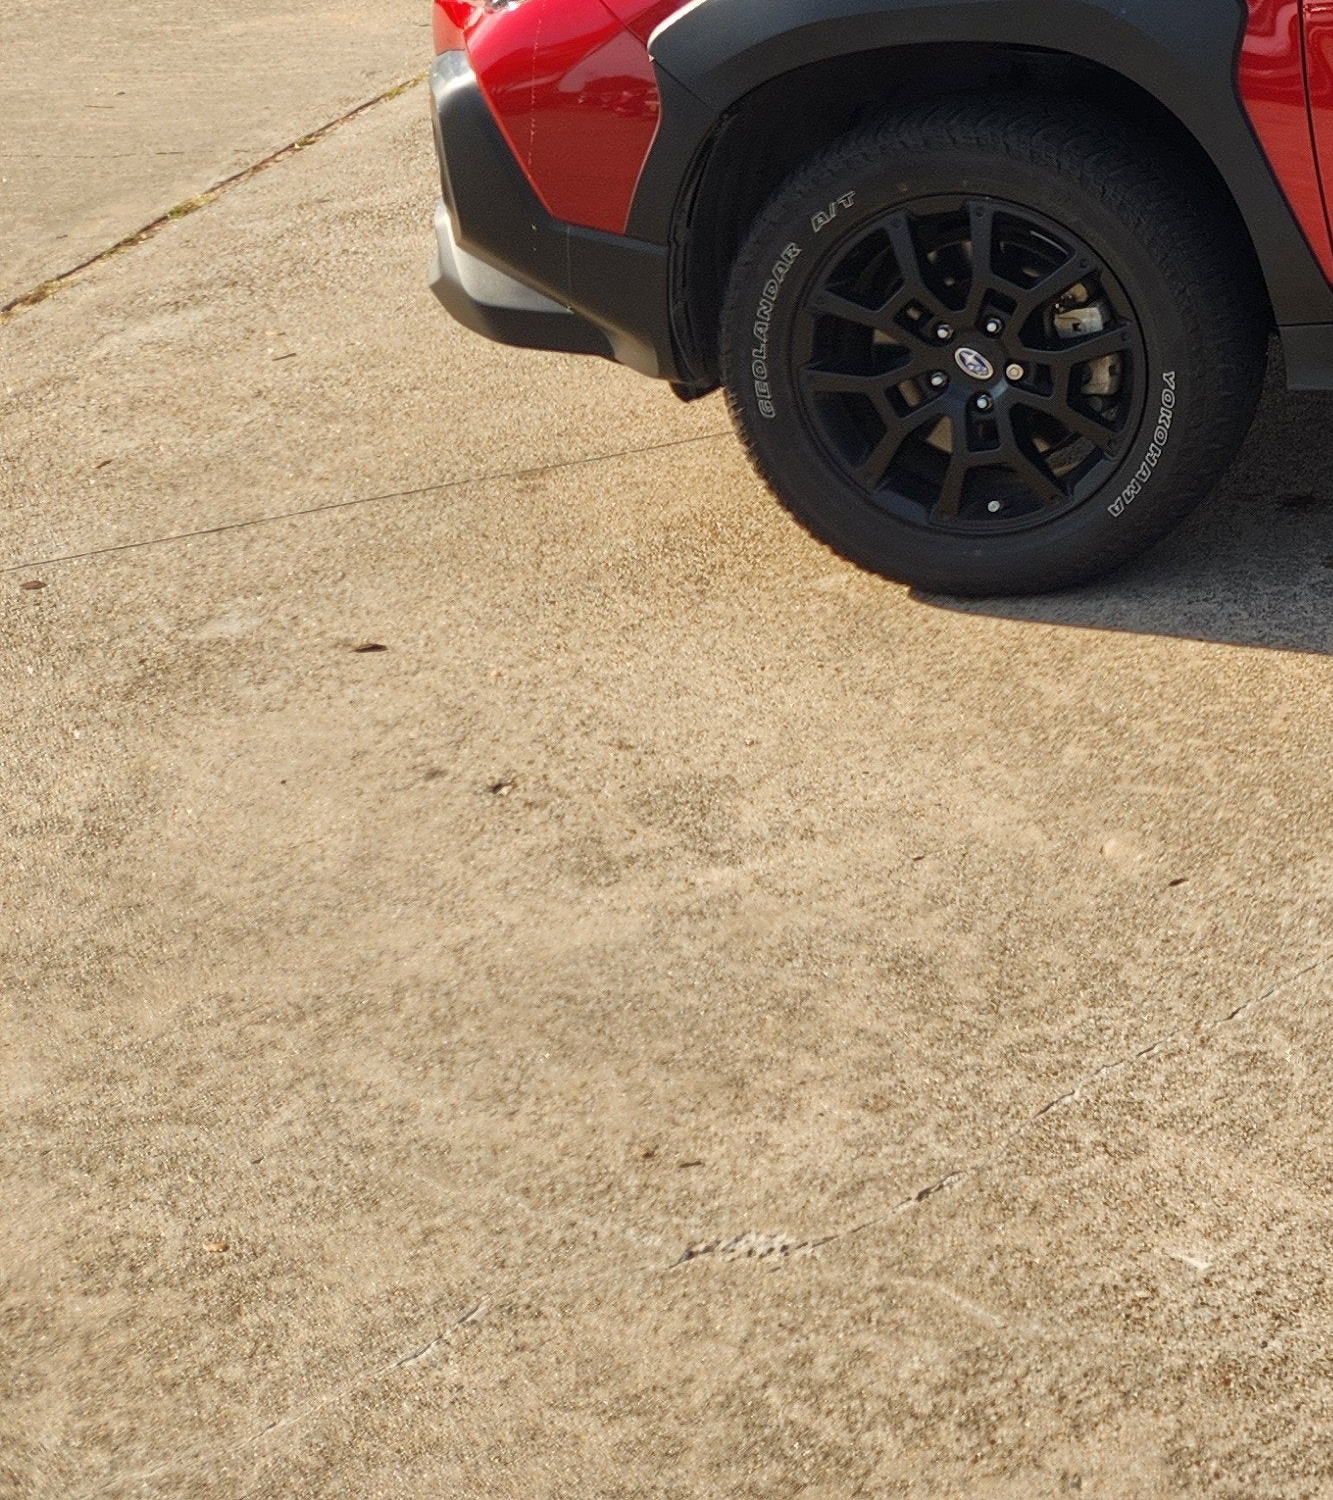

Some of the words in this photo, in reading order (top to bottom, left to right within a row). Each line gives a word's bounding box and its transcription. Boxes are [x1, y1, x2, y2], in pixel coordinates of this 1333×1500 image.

[752, 241, 802, 419] GEOLANDAR
[811, 190, 856, 233] A/T
[1107, 369, 1177, 518] YOKOHAMA
